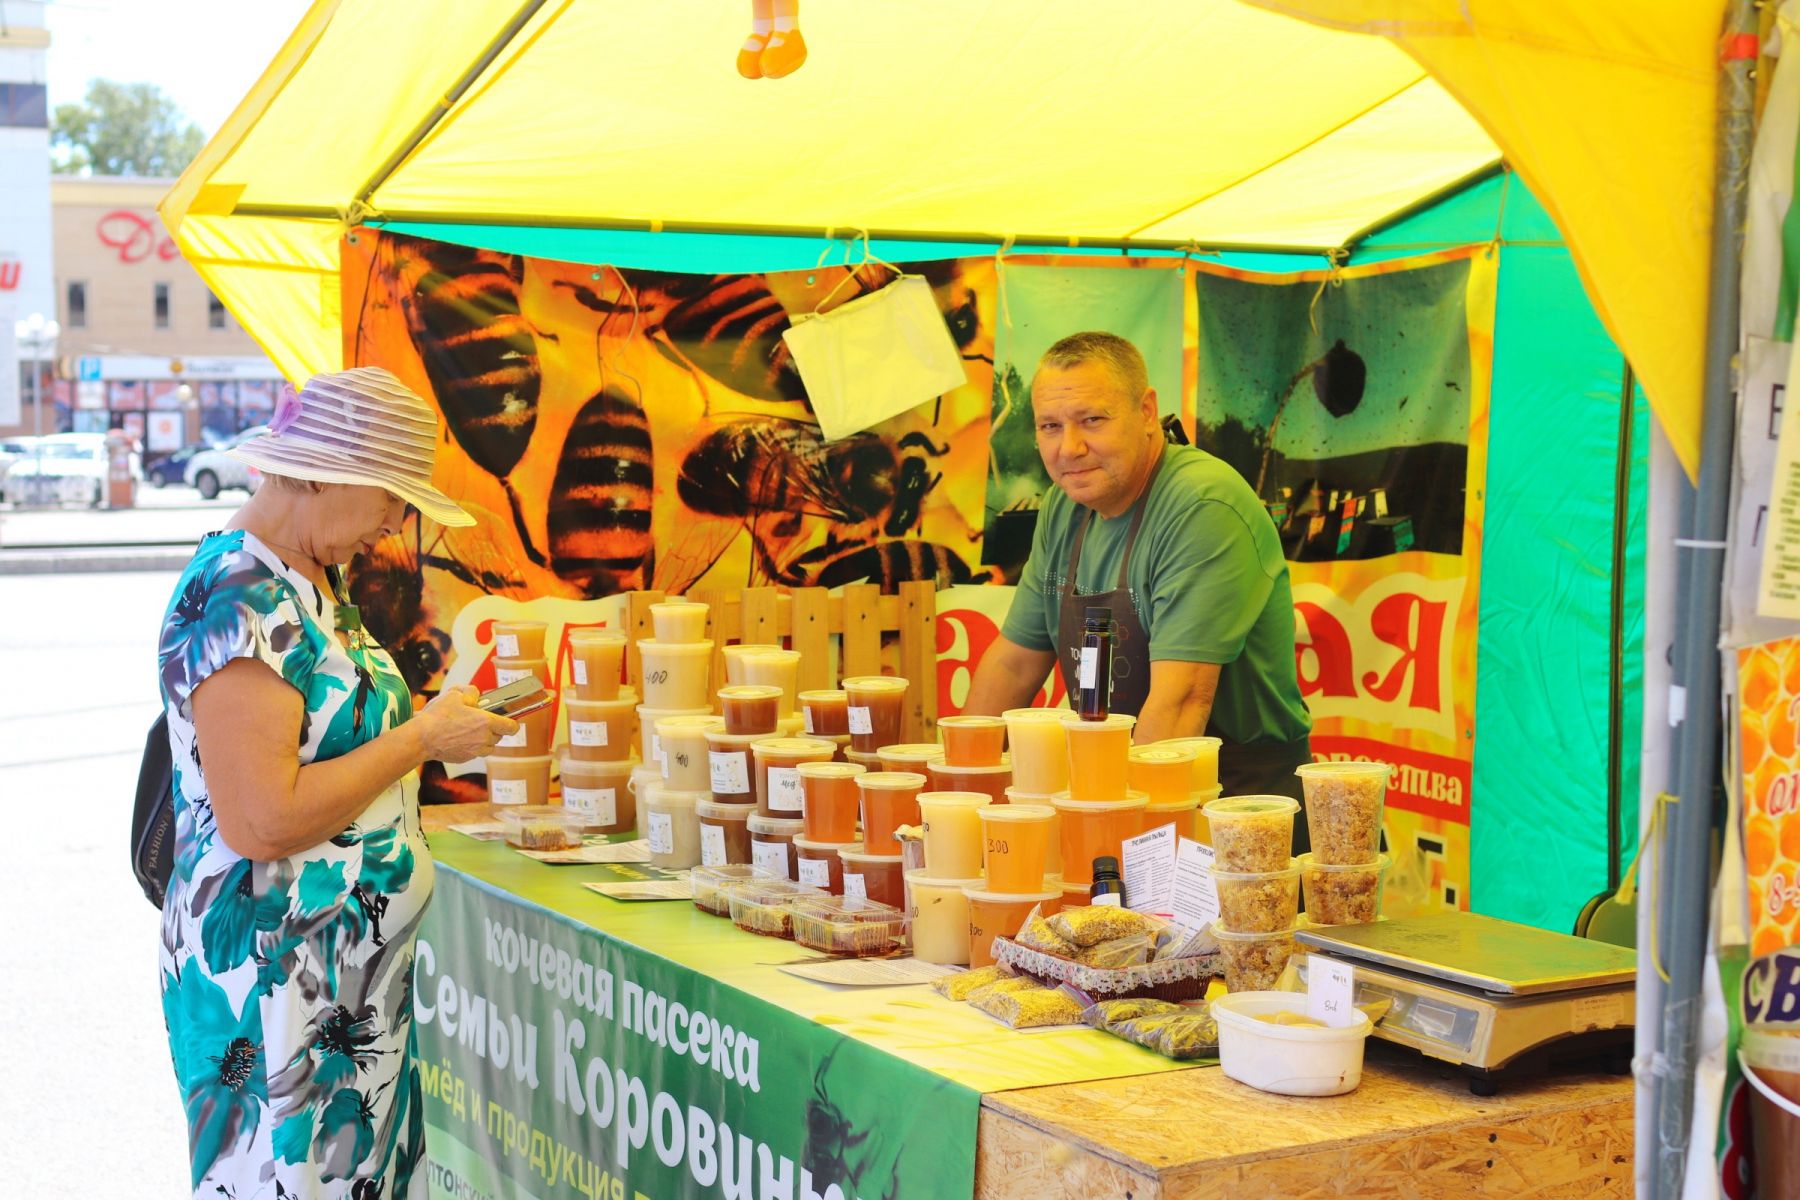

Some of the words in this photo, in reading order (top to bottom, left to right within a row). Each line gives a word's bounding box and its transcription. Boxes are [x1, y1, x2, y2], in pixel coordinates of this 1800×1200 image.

[149, 820, 169, 869] FASHION
[988, 839, 1009, 854] 300
[413, 940, 539, 1090] Семьи
[554, 1009, 862, 1200] Коровин
[485, 917, 614, 1020] кочевая
[623, 980, 761, 1093] пасека
[420, 1059, 466, 1123] мёд
[471, 1087, 482, 1128] и
[487, 1099, 625, 1200] продукция
